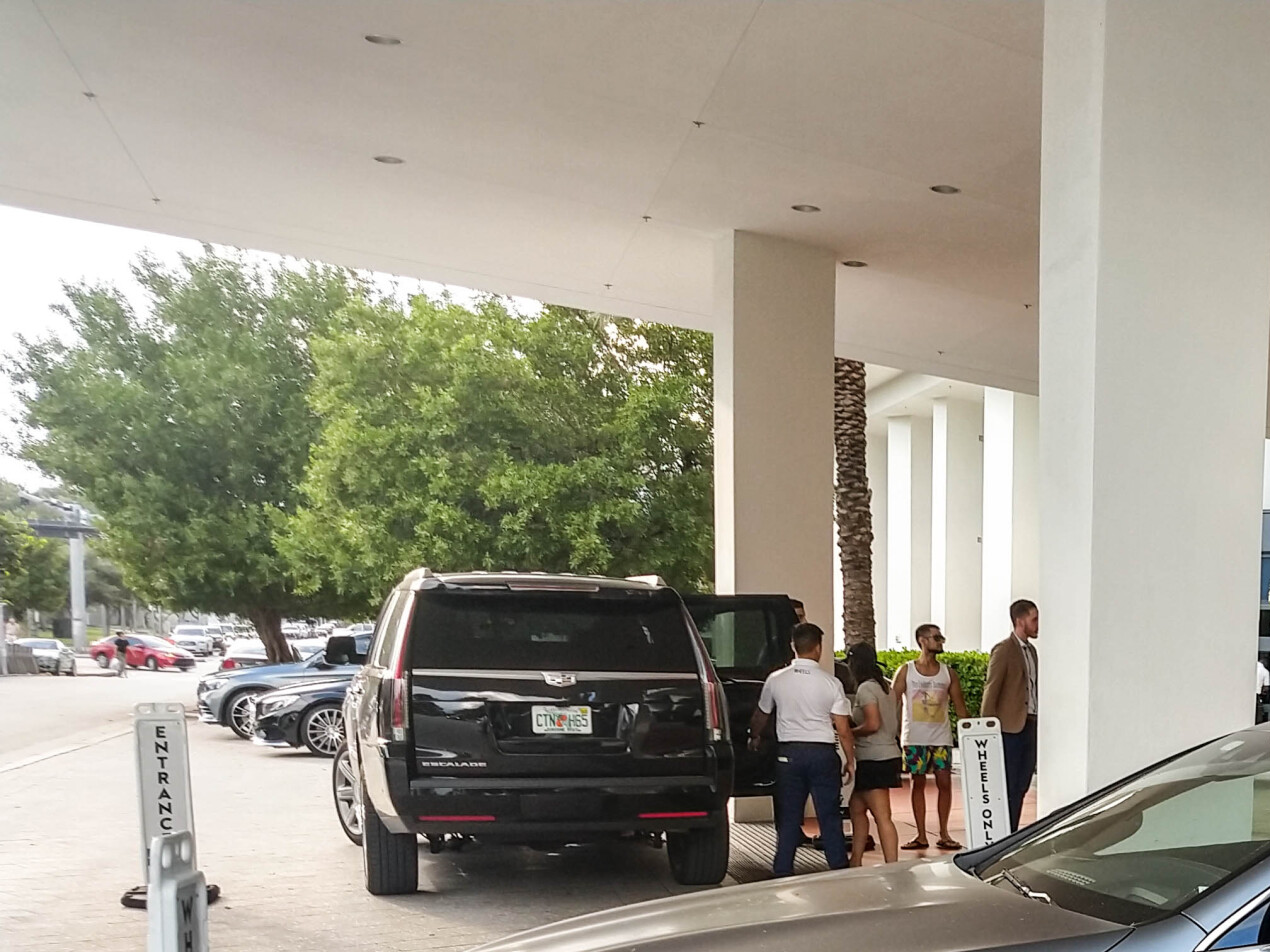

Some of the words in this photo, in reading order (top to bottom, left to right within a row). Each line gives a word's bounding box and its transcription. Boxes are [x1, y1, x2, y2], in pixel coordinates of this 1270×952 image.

[536, 713, 556, 727] CTN
[155, 725, 173, 836] ENTRANC
[975, 739, 990, 804] WHEELS
